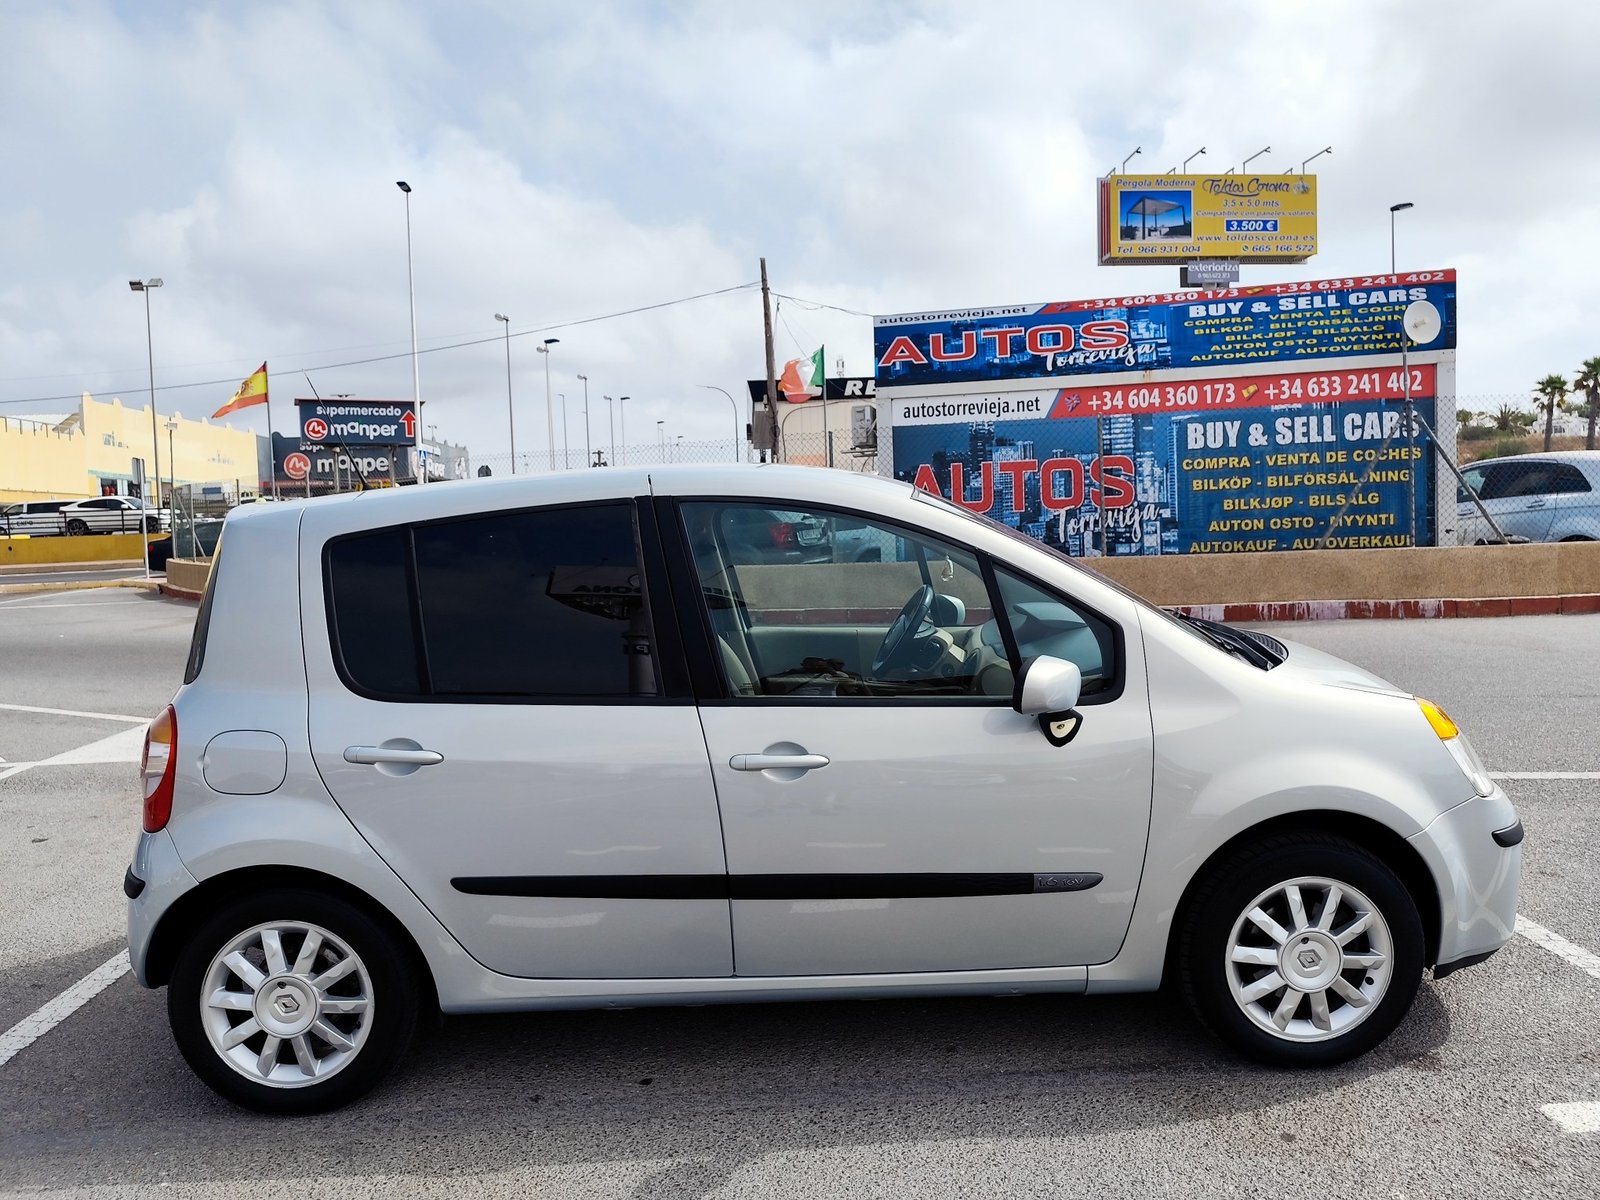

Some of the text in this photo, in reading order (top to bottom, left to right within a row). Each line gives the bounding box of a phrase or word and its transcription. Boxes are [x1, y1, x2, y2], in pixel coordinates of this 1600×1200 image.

[1116, 179, 1196, 188] Pergola Moderna
[1202, 178, 1290, 196] Toldos Corona
[1263, 199, 1280, 207] mts
[1229, 220, 1275, 231] 3.500 €
[1138, 246, 1157, 254] 966
[1182, 245, 1201, 253] 004
[1252, 244, 1314, 252] 665 166 572
[1188, 262, 1239, 272] exterioriza
[1270, 271, 1445, 294] +34 633 241 402
[1078, 288, 1239, 310] +34 604 360 173
[1188, 287, 1428, 318] BUY & SELL CARS
[879, 306, 1028, 325] autostorrevieja.net
[1183, 316, 1253, 327] COMPRA
[1268, 310, 1324, 321] VENTA
[1329, 308, 1352, 316] DE
[1358, 304, 1406, 314] COCH
[1194, 324, 1254, 335] BILKÖP
[1270, 314, 1402, 330] BILFÖRSÄLJNIN
[1210, 341, 1267, 352] AUTON
[1272, 337, 1318, 347] OSTO
[1333, 332, 1401, 343] MYYNTI
[1225, 331, 1297, 342] BILKJØP
[1312, 324, 1385, 337] BILSALG
[878, 319, 1130, 367] AUTOS
[1041, 343, 1156, 371] Torrevieja
[1190, 350, 1280, 362] AUTOKAUF
[1264, 370, 1423, 400] +34 633 241 402
[1087, 383, 1236, 411] +34 604 360 173
[316, 405, 402, 418] supermercado
[903, 396, 1041, 420] autostorrevieja.net
[330, 421, 398, 440] manper
[1187, 420, 1241, 450] BUY
[1248, 423, 1268, 446] &
[1275, 414, 1337, 446] SELL
[1182, 456, 1251, 471] COMPRA
[1265, 452, 1321, 467] VENTA
[1325, 450, 1348, 464] DE
[914, 455, 1135, 513] AUTOS
[1192, 476, 1252, 491] BILKÖP
[1223, 496, 1293, 511] BILKJØP
[1053, 501, 1160, 543] Torrvieja
[1208, 518, 1265, 532] AUTON
[1269, 516, 1315, 530] OSTO
[1189, 538, 1277, 554] AUTOKAUF
